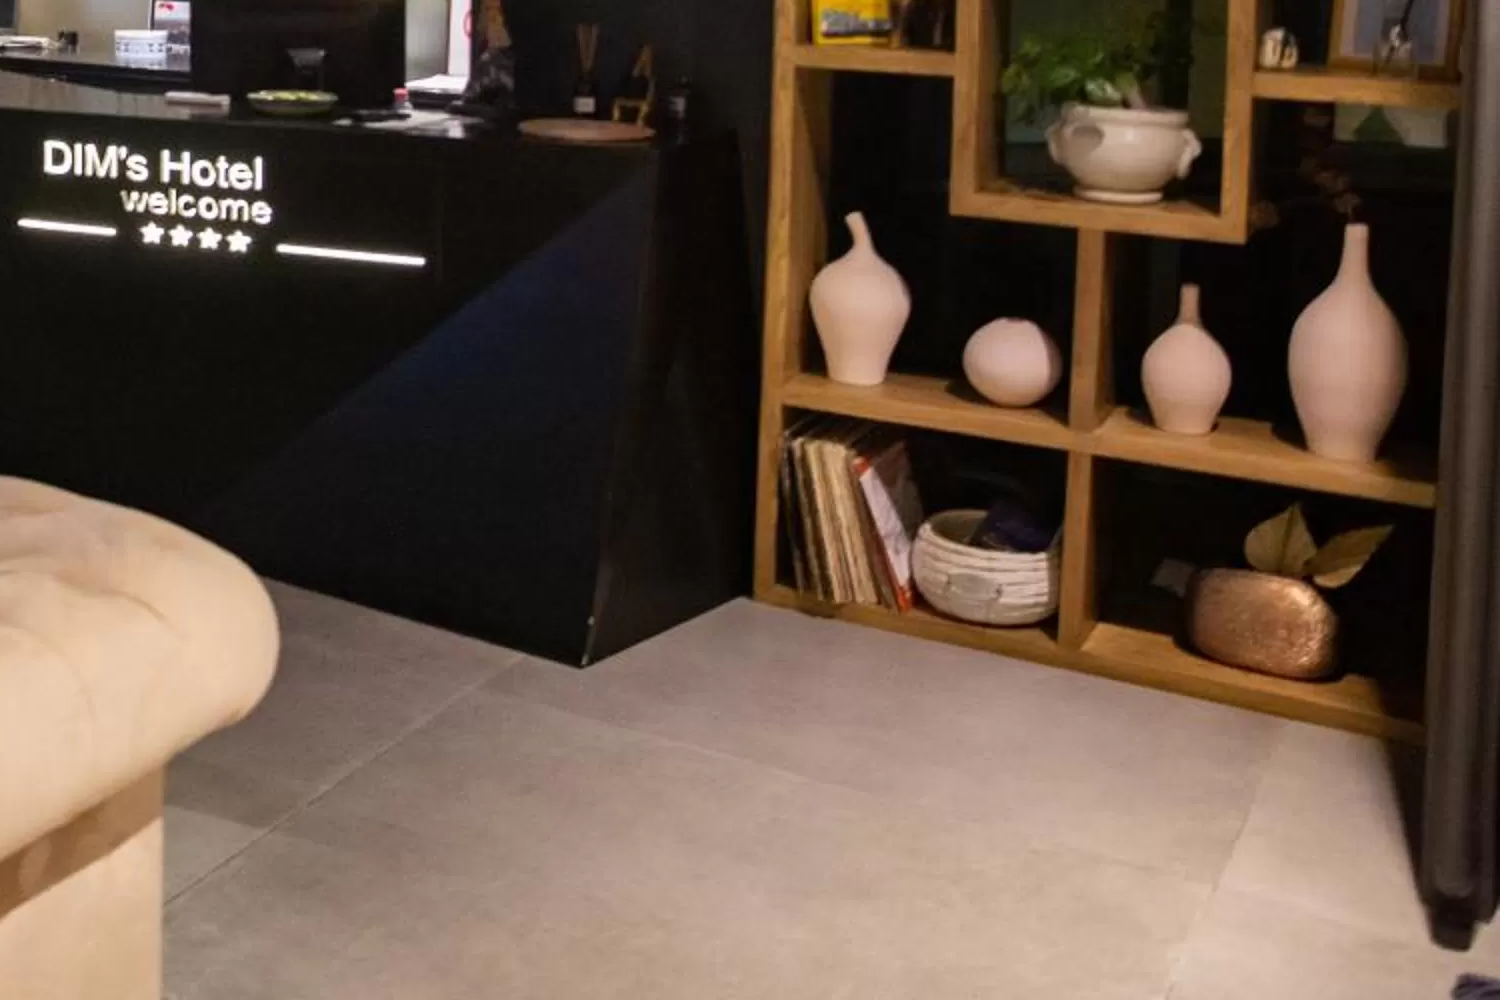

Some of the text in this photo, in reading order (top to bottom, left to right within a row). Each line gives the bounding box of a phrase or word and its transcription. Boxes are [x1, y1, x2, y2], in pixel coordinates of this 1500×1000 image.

[43, 139, 263, 192] DIM's Hotel
[120, 187, 273, 225] welcome
